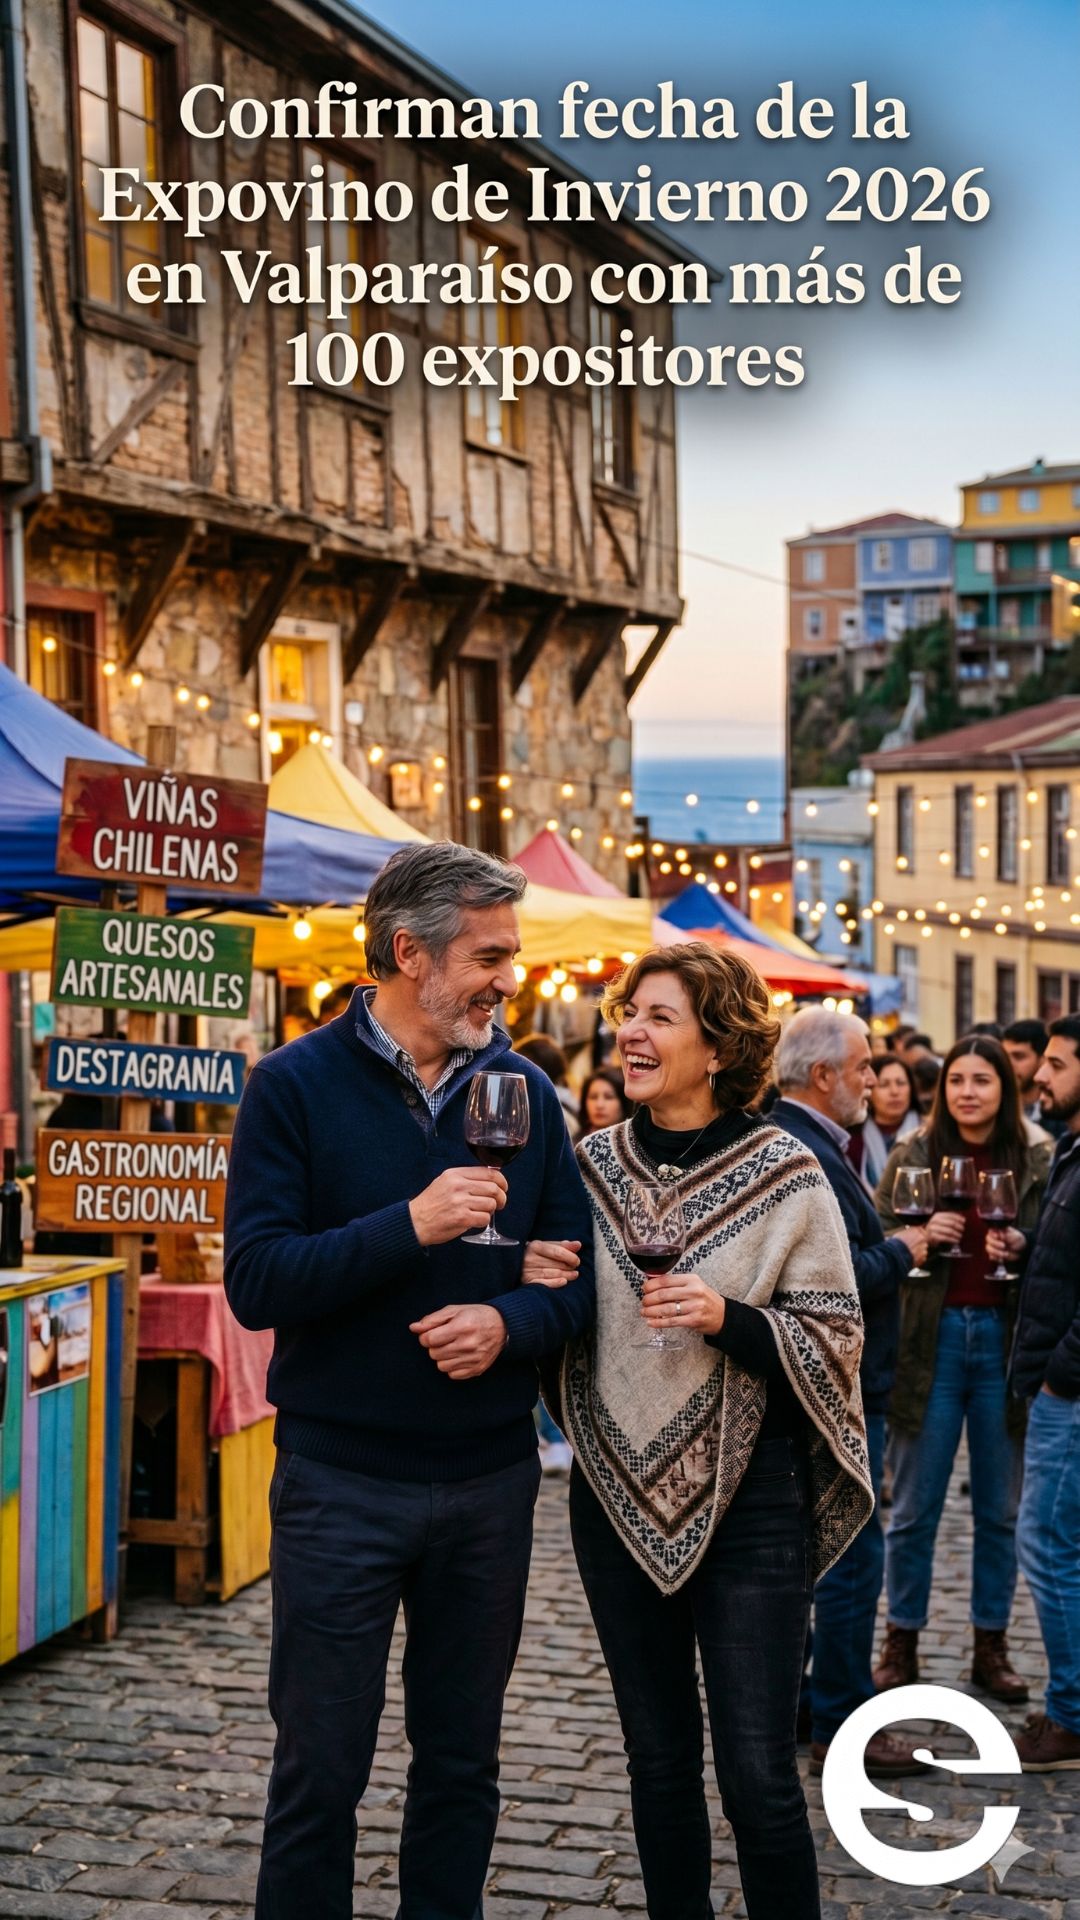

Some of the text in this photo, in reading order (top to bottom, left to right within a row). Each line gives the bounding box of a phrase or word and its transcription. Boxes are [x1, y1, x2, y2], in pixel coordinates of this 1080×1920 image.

[124, 775, 218, 829] VIÑAS
[93, 828, 238, 883] CHILENAS
[102, 919, 215, 963] QUESOS
[59, 959, 244, 1010] ARTESANALES
[56, 1045, 235, 1094] DESTAGRANÍA
[49, 1138, 228, 1181] GASTRONOMÍA
[76, 1184, 215, 1224] REGIONAL
